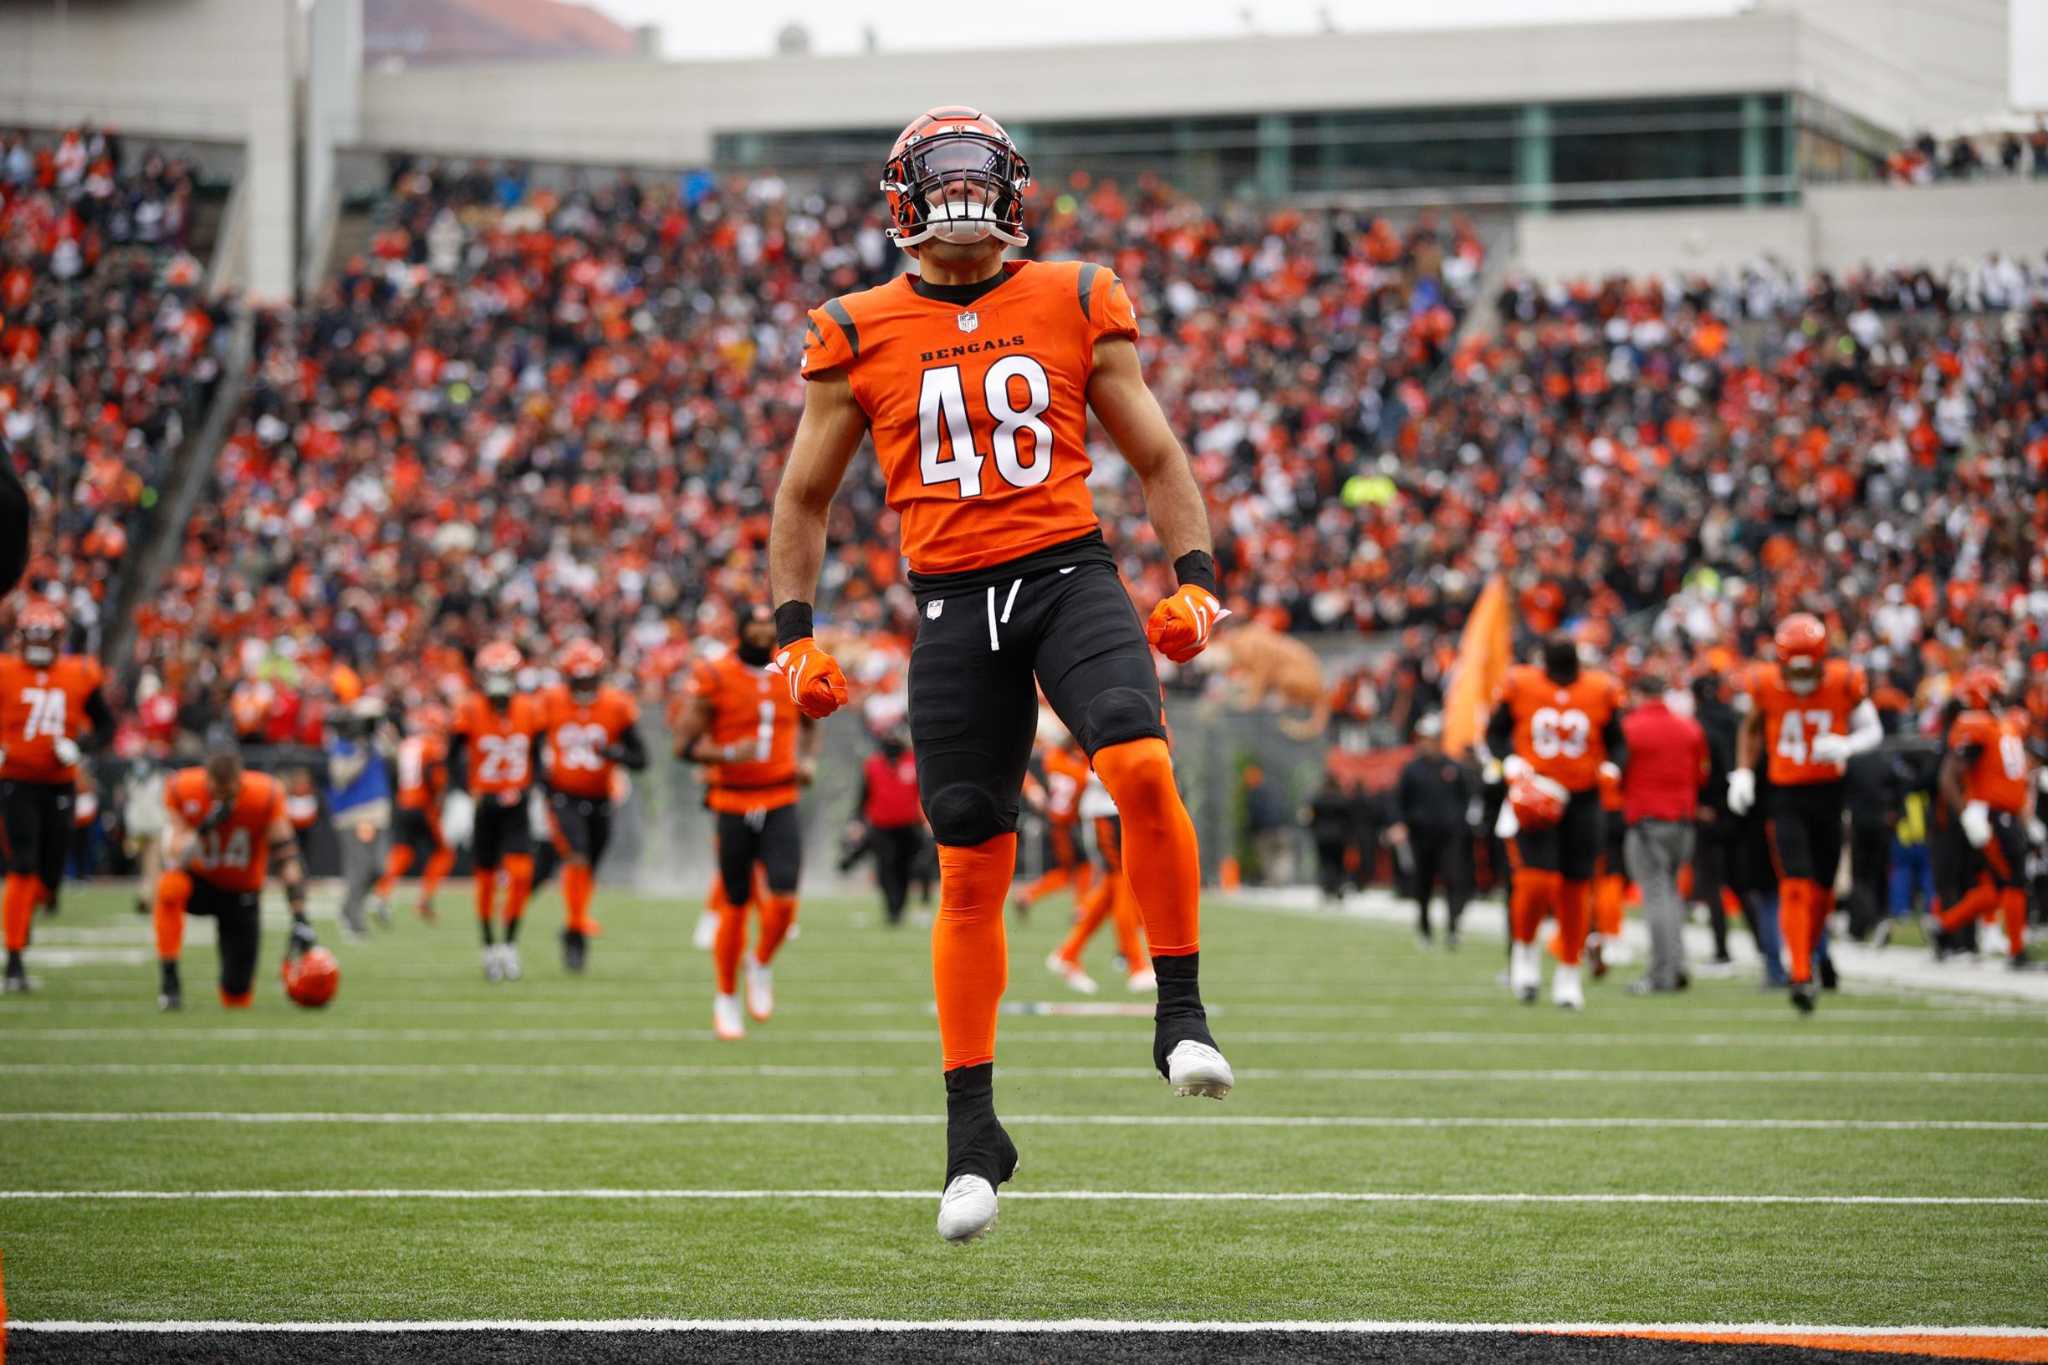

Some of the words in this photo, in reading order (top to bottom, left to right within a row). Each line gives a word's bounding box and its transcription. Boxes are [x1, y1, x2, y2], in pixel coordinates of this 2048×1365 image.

[920, 335, 1025, 362] BENGALS
[918, 353, 1055, 500] 48
[21, 687, 66, 741] 74
[1531, 707, 1589, 758] 63
